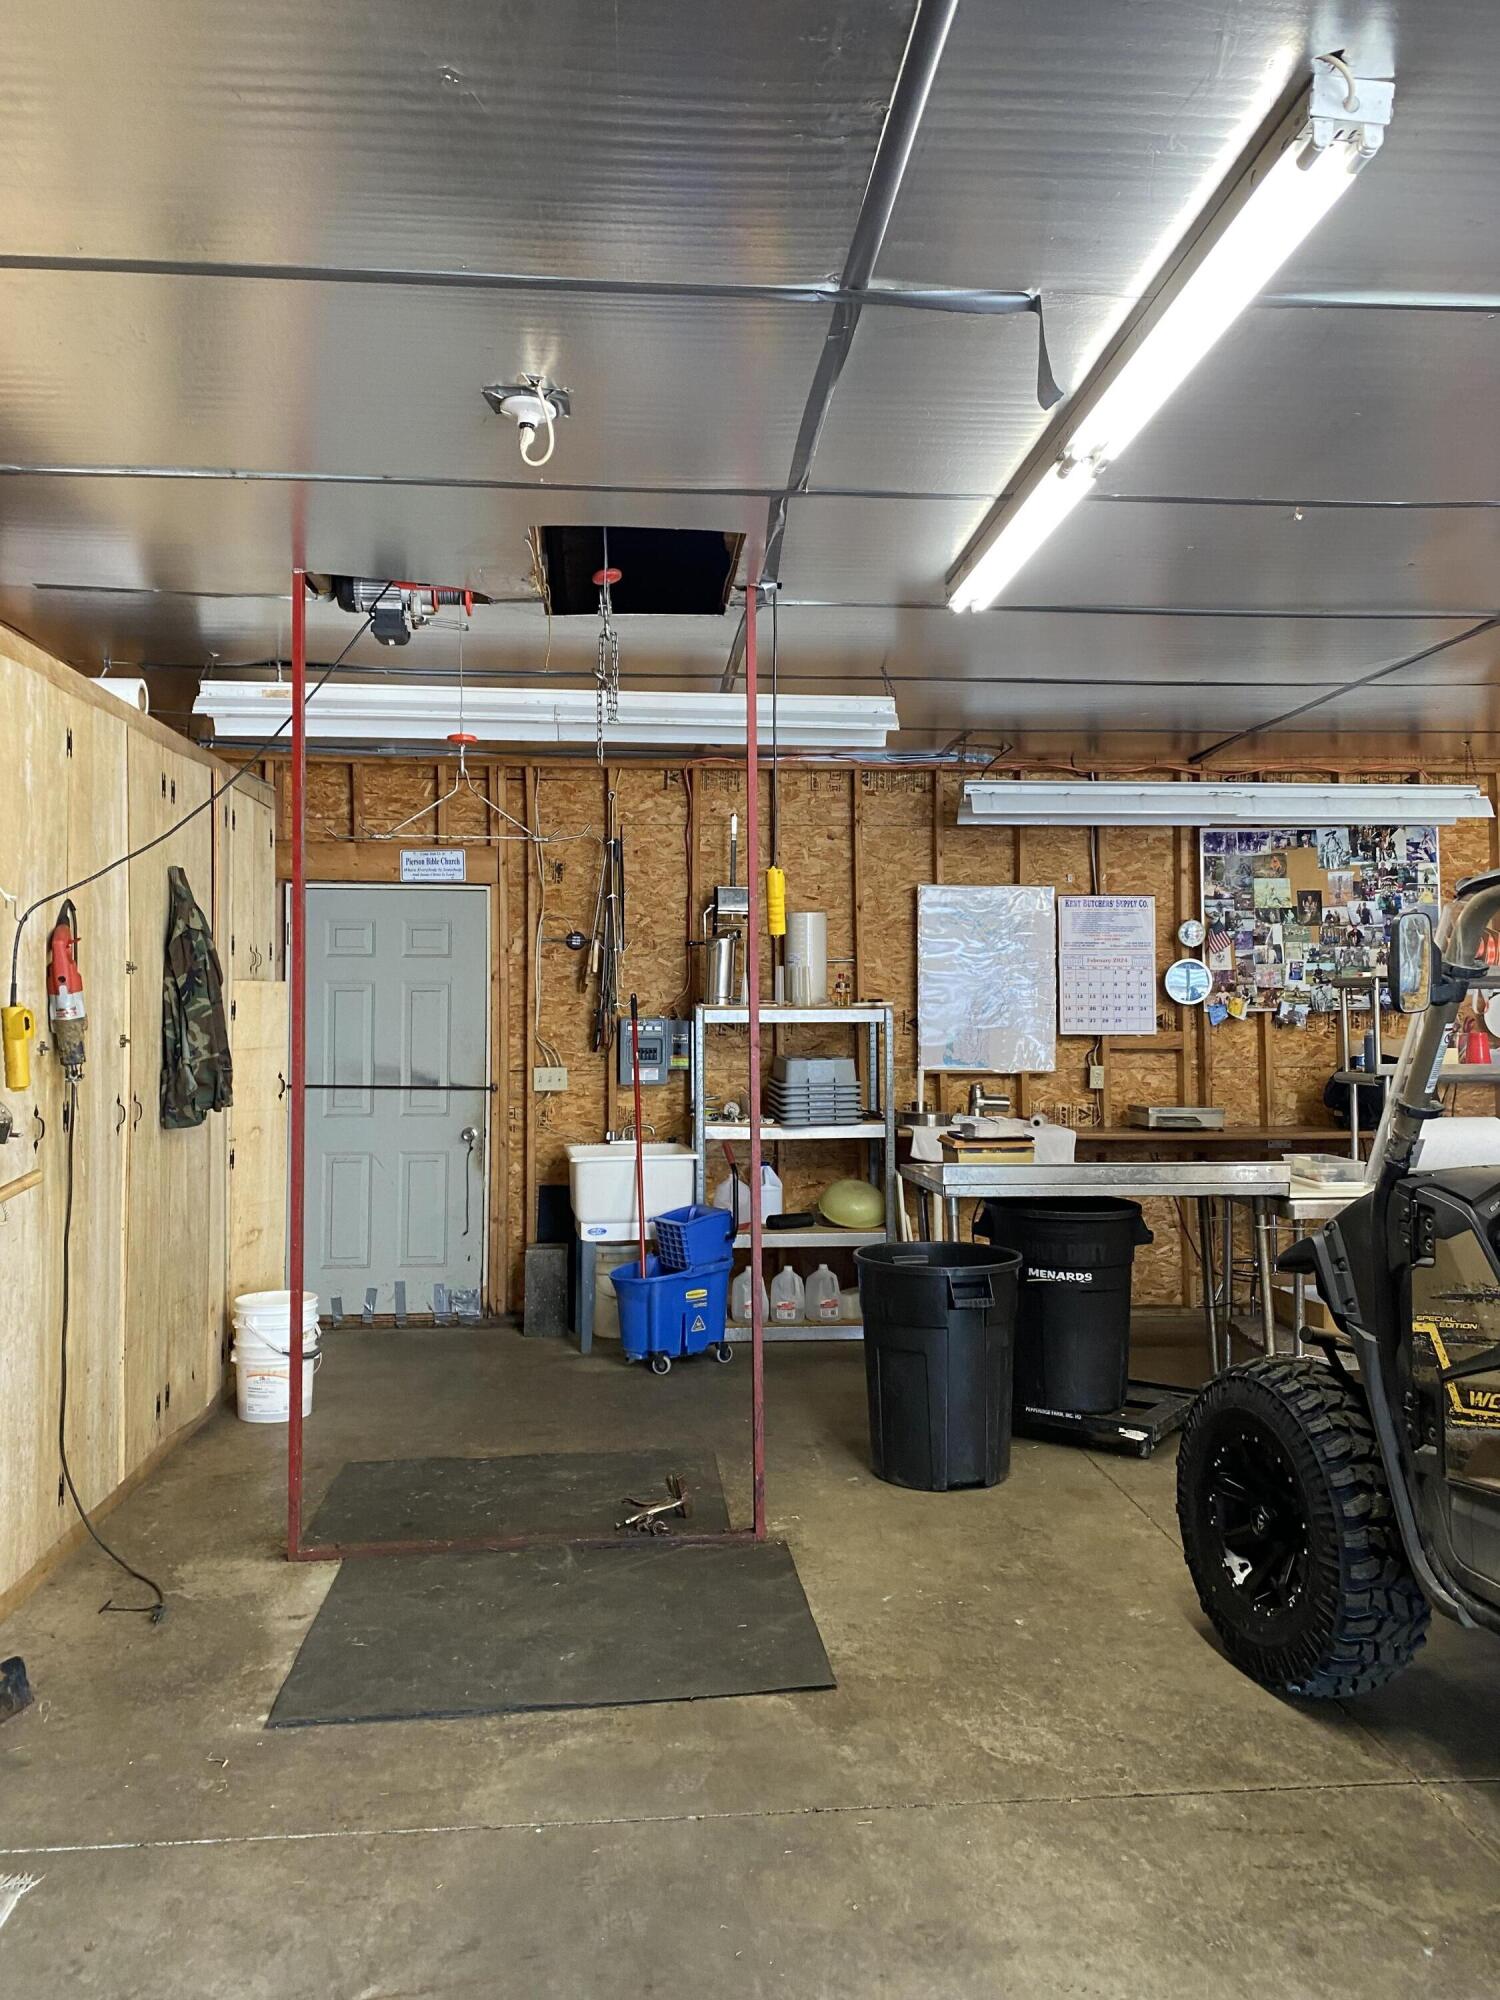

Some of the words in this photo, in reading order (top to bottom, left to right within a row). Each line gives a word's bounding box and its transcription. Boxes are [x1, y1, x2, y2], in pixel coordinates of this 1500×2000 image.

[406, 857, 424, 866] Pierson
[426, 857, 439, 865] Bible
[440, 857, 460, 865] Church
[1139, 899, 1149, 908] CO.
[1087, 957, 1112, 965] February
[1028, 1267, 1093, 1282] MENARDS
[1439, 1322, 1478, 1330] EDITION
